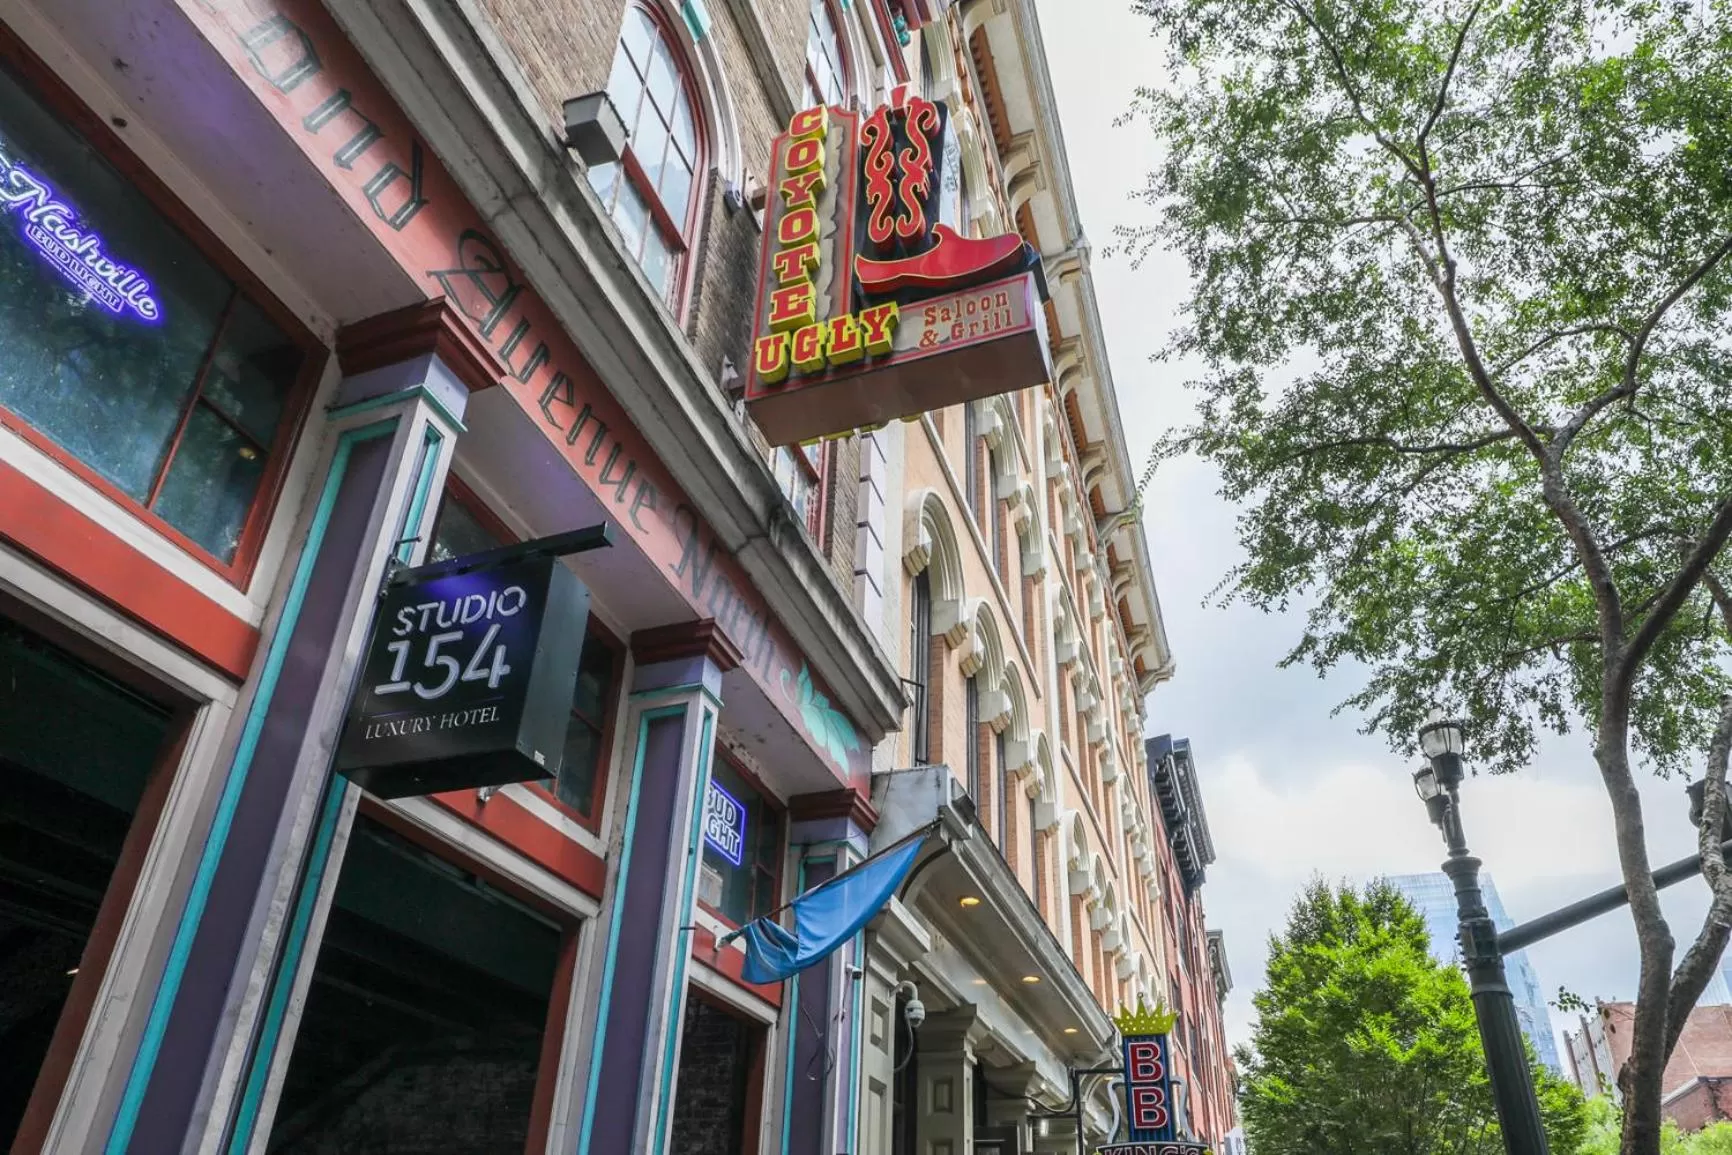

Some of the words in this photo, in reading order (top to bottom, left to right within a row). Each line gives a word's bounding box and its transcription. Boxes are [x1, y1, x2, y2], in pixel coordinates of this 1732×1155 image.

[8, 168, 158, 319] Nashville
[768, 103, 828, 333] COYOTE
[919, 330, 941, 350] &
[951, 309, 1013, 340] Grill
[924, 291, 1008, 326] Saloon
[194, 0, 429, 232] ond
[426, 229, 659, 536] Avenue
[669, 503, 776, 685] North
[755, 301, 899, 384] UGLY
[392, 586, 527, 636] STUDIO
[374, 623, 512, 699] 154
[365, 715, 436, 740] LUXURY
[440, 706, 500, 730] HOTEL
[707, 813, 741, 857] GHT
